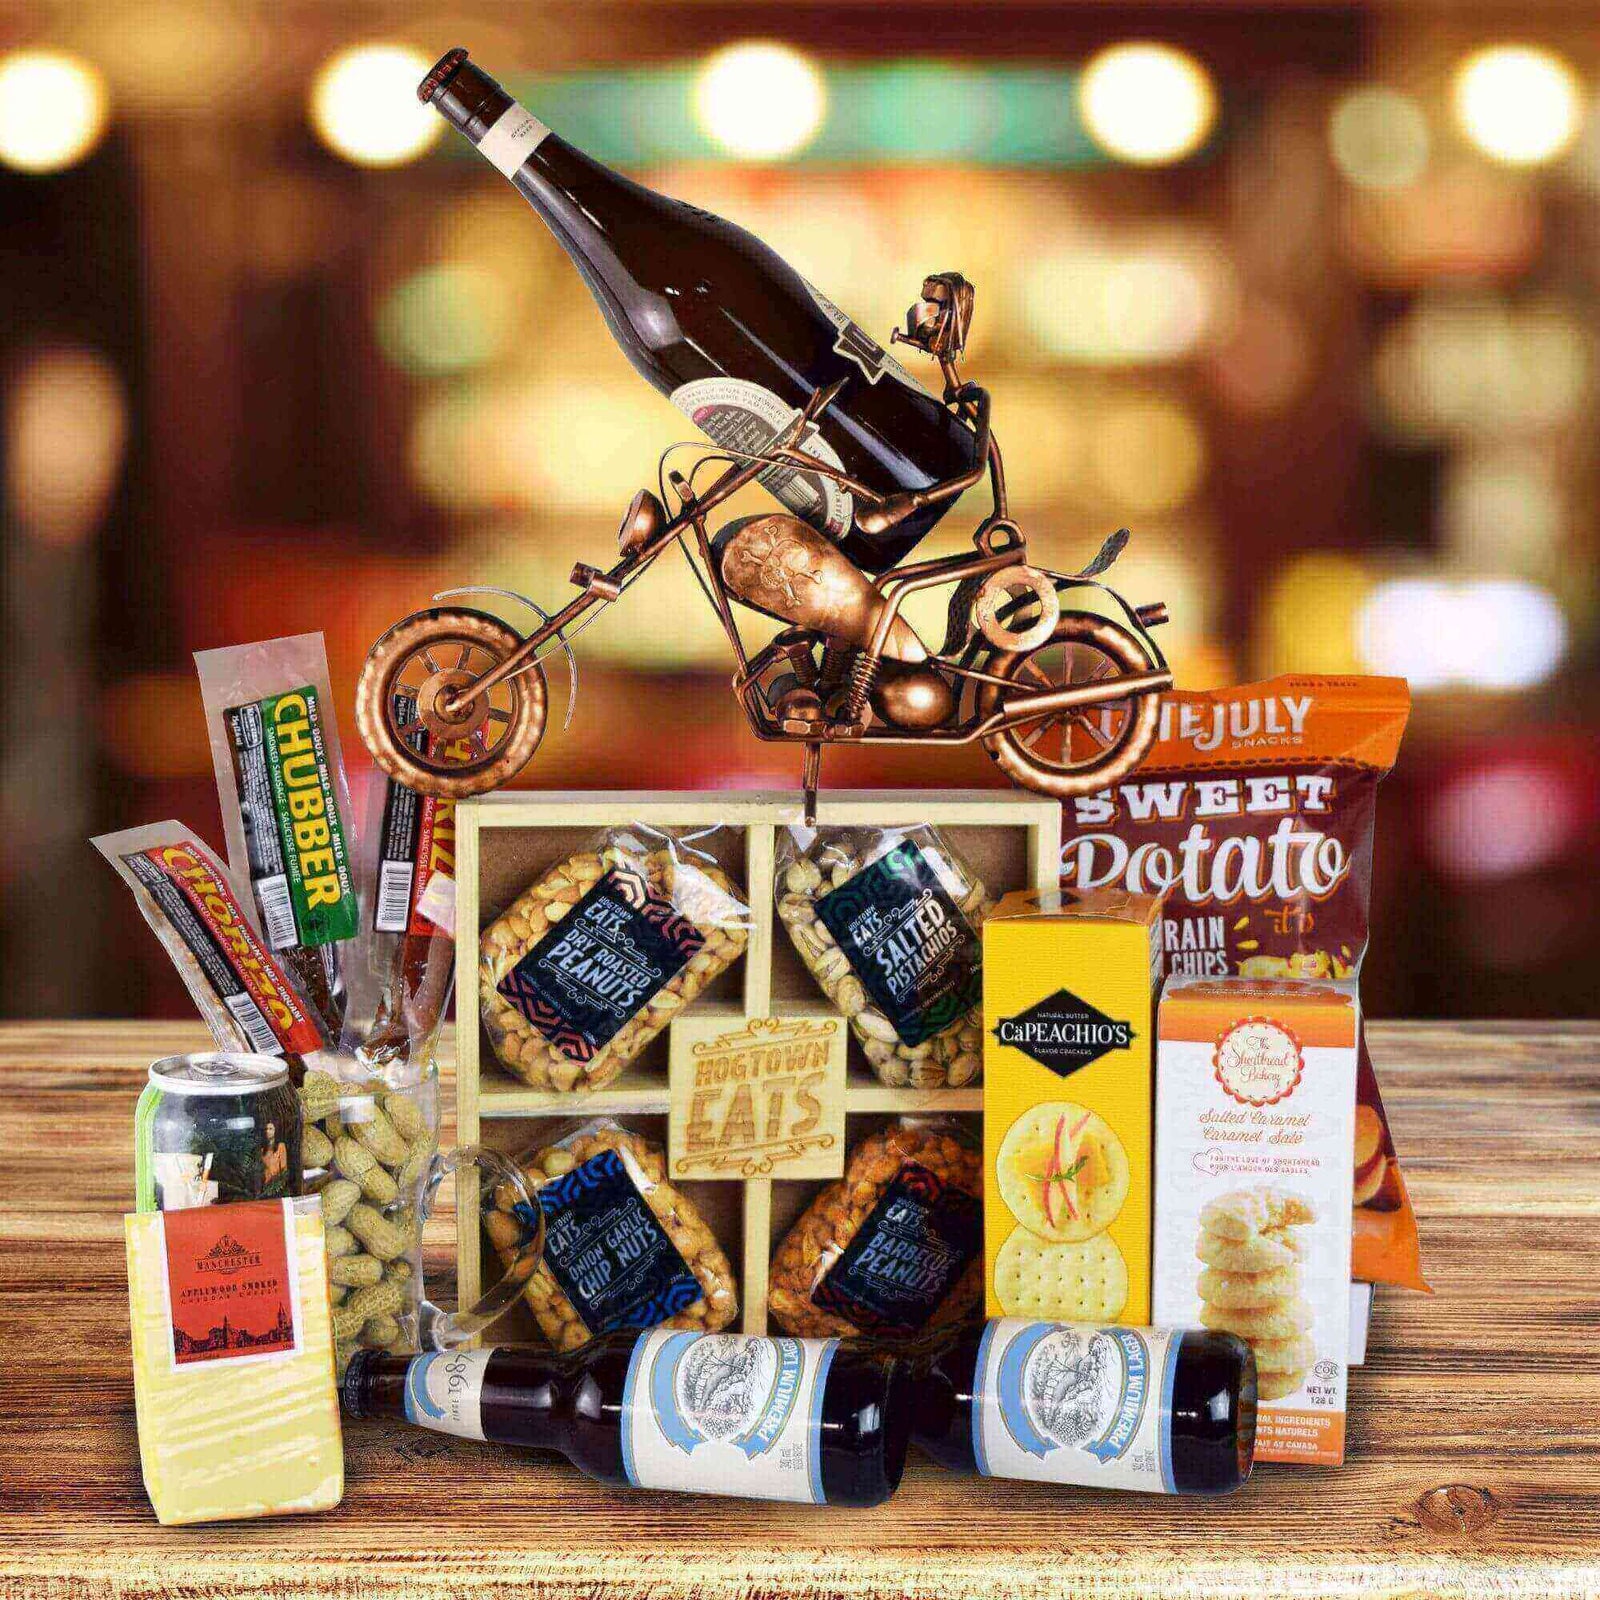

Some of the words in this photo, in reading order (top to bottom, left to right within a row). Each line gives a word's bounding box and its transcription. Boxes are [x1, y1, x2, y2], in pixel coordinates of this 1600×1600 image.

[305, 695, 318, 721] MILD
[264, 727, 279, 763] SMOKED
[311, 727, 325, 757] DOUX
[1231, 737, 1302, 749] SNACKS
[271, 763, 287, 804] SAUSAGE
[317, 763, 330, 790] MILD
[274, 693, 341, 910] CHUBBER
[324, 796, 337, 826] DOUX
[1075, 775, 1334, 824] SWEET
[280, 811, 296, 852] SAUCISSE
[331, 833, 343, 858] MILD
[1060, 817, 1352, 901] Potato
[337, 865, 350, 895] DOUX
[584, 902, 625, 932] EATS
[599, 896, 633, 920] HOGTOWN
[852, 912, 885, 947] EATS
[875, 899, 945, 976] SALTED
[1164, 916, 1225, 952] RAIN
[546, 942, 644, 1007] PEANUTS
[565, 929, 598, 954] DRY
[594, 949, 651, 989] ROASTED
[886, 920, 958, 996] PISTACHIOS
[1171, 950, 1229, 976] CHIPS
[264, 964, 278, 982] HOT
[278, 985, 305, 1023] PIQUANT
[1227, 1043, 1290, 1068] Shortbread
[1246, 1036, 1269, 1050] The
[694, 1040, 830, 1087] HOGTOWN
[1240, 1067, 1280, 1088] Bakery
[685, 1071, 826, 1152] EATS
[1199, 1108, 1247, 1123] Salted
[1250, 1111, 1311, 1126] Caramel
[1203, 1126, 1263, 1142] Caramel
[885, 1204, 925, 1227] EATS
[546, 1219, 581, 1256] EATS
[568, 1243, 604, 1282] ONION
[605, 1208, 647, 1247] GARLIC
[868, 1231, 956, 1274] BARBECUE
[197, 1255, 261, 1270] MANCHESTER
[578, 1261, 612, 1299] CHIP
[616, 1224, 658, 1268] NUTS
[855, 1250, 948, 1293] PEANUTS
[180, 1284, 238, 1297] APPLEWOOD
[242, 1279, 278, 1290] SMOKED
[1121, 1334, 1145, 1370] LAGER
[757, 1370, 797, 1441] PREMIUM
[1108, 1375, 1144, 1448] PREMIUM
[1275, 1416, 1331, 1428] INGREDIENTS
[1275, 1428, 1318, 1437] NATURELS
[1286, 1442, 1318, 1450] CANADA
